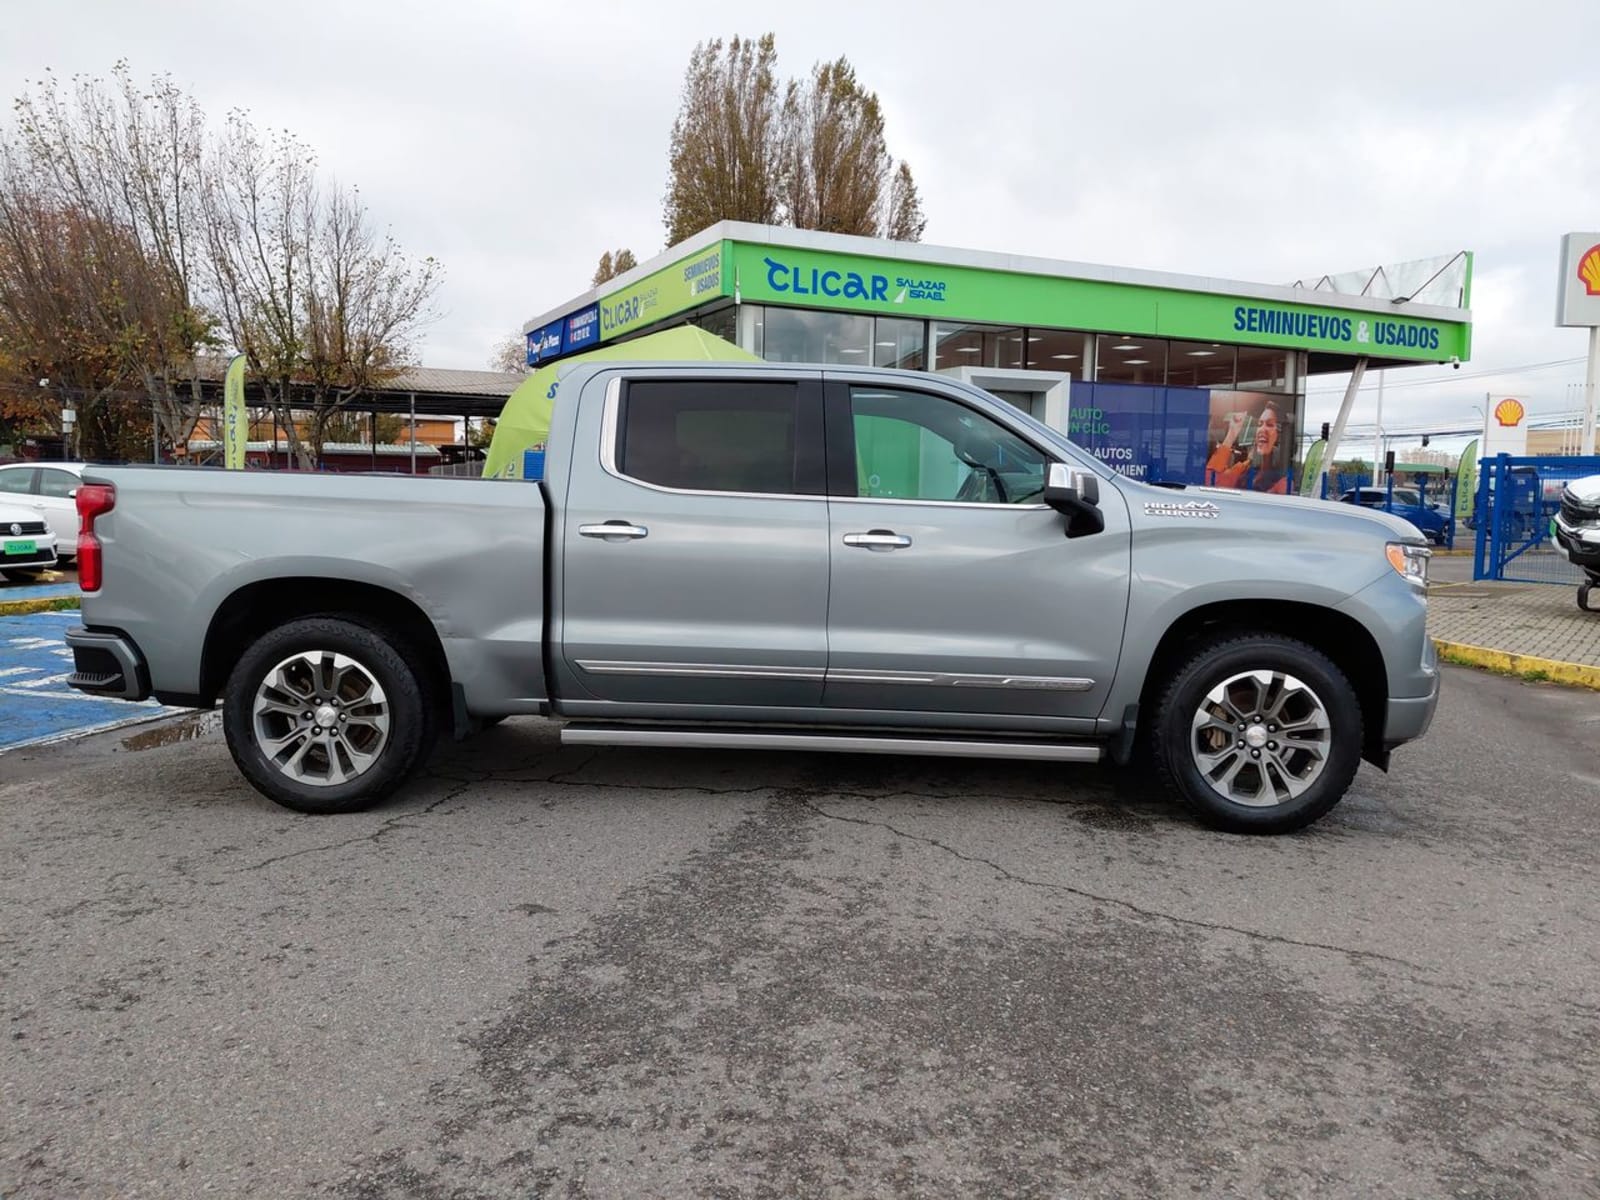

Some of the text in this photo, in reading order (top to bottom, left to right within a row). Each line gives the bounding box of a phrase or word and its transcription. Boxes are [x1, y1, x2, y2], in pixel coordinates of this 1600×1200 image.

[895, 277, 946, 292] SALAZAR
[909, 289, 945, 301] ISRAEL
[1233, 306, 1440, 350] SEMINUEVOS & USADOS
[1070, 408, 1103, 420] AUTO
[1069, 423, 1110, 434] N CLIC
[1094, 447, 1133, 460] AUTOS
[1110, 464, 1148, 476] MIENT
[1144, 502, 1182, 510] HIGH
[1144, 509, 1219, 519] COUNTRY
